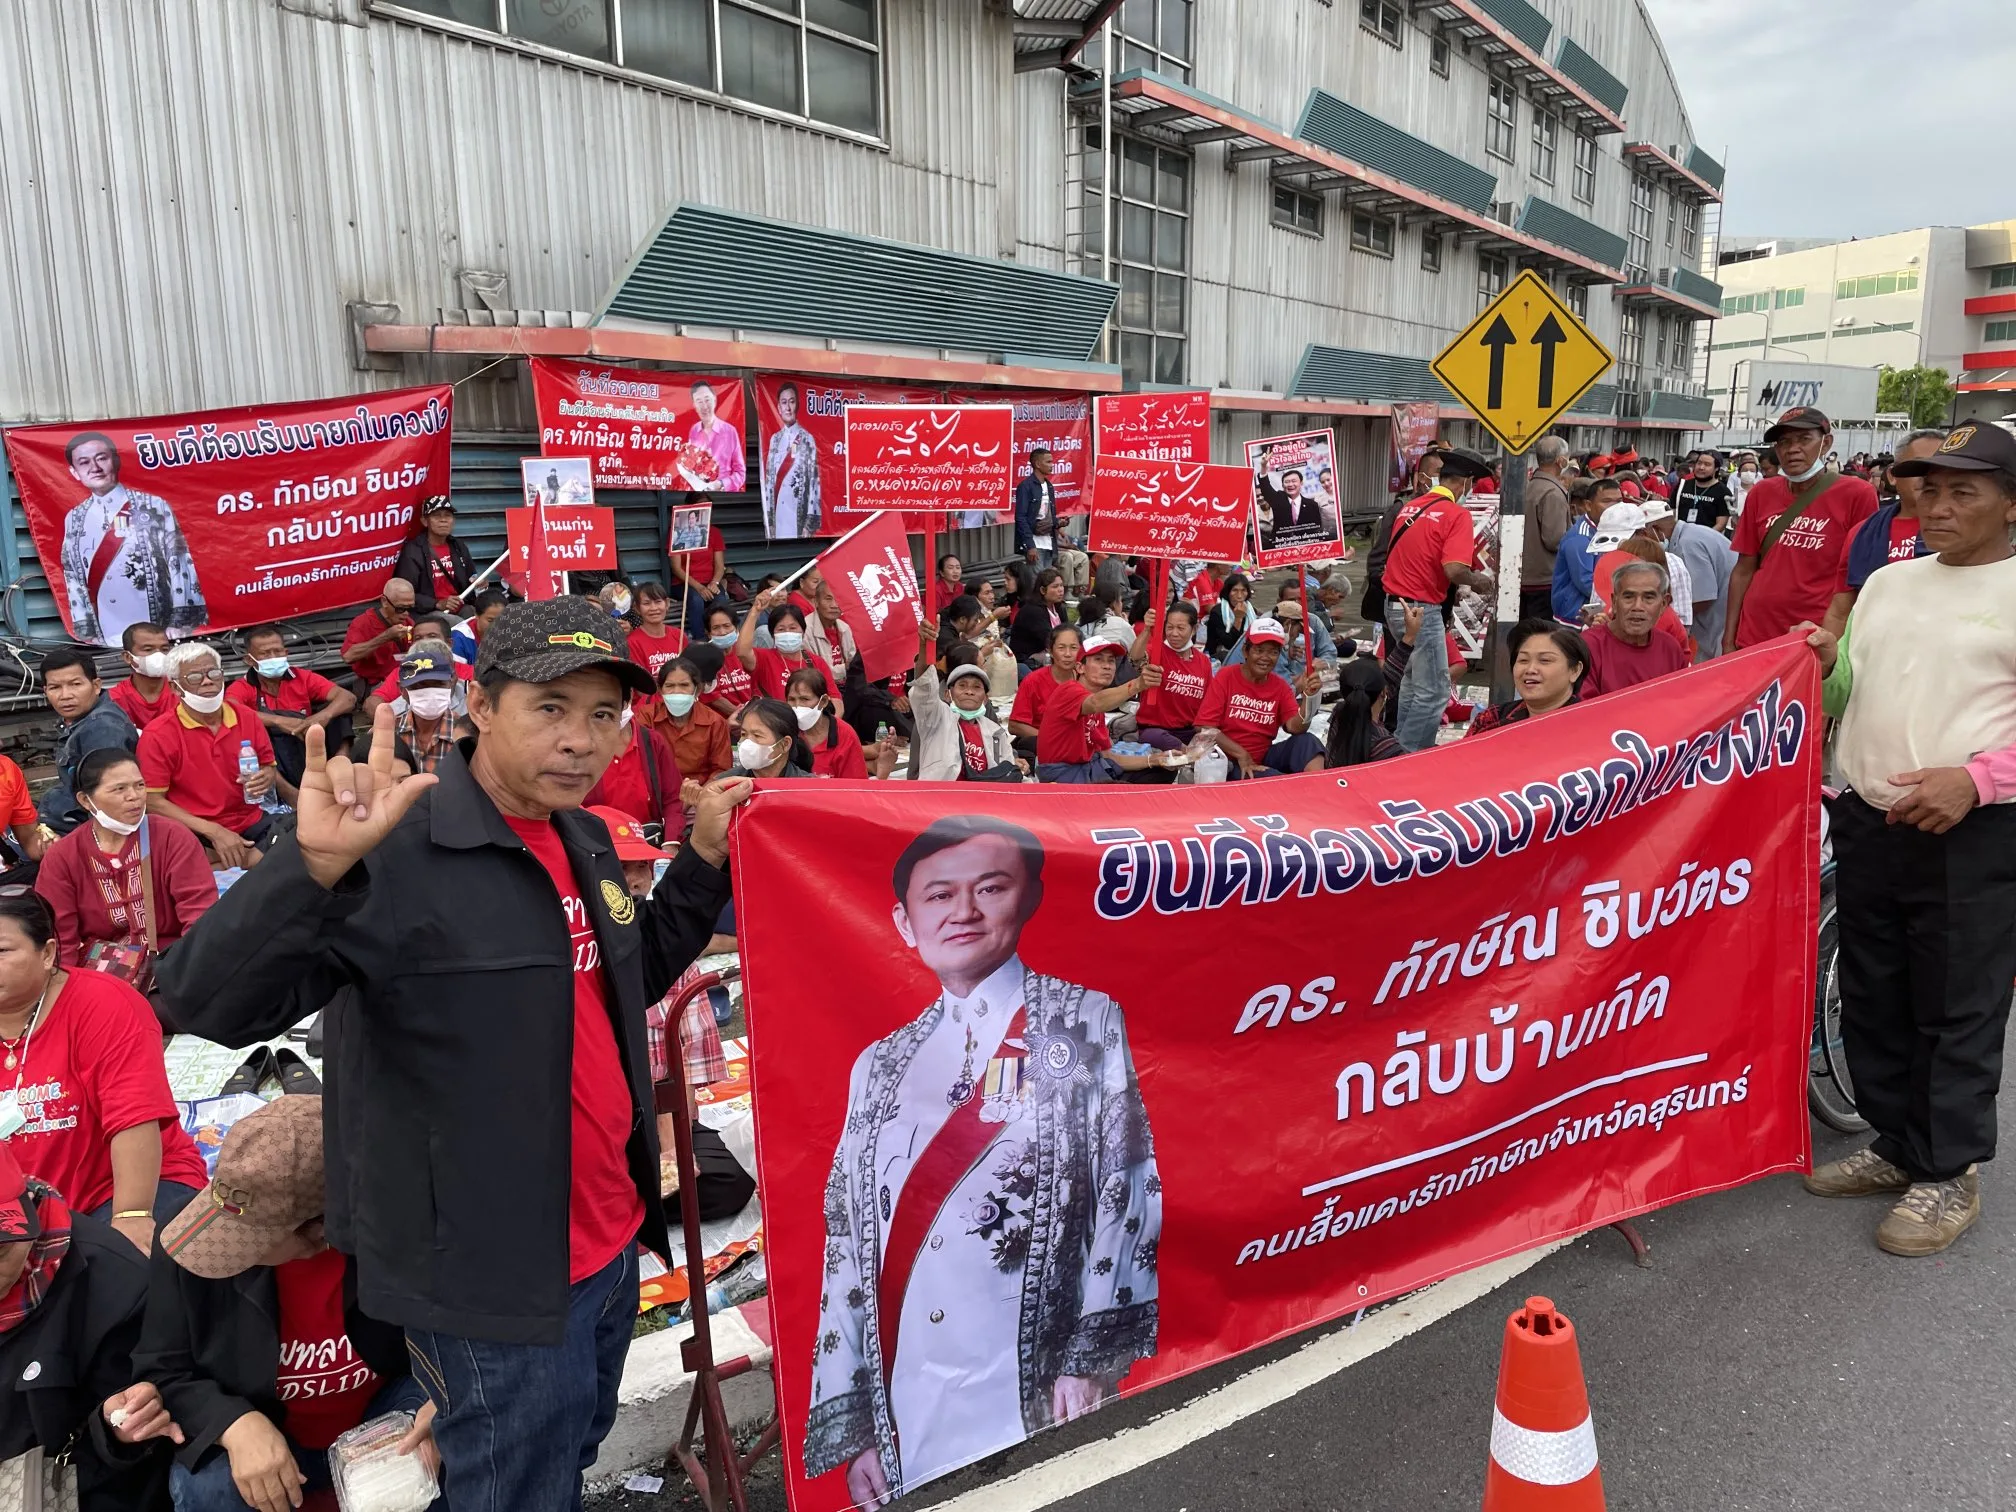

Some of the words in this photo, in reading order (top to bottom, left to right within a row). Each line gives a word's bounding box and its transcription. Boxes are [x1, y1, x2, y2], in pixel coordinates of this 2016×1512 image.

[577, 369, 660, 398] วันที่รอคอย
[1756, 379, 1824, 414] MJETS
[543, 421, 625, 448] ดร.ทักษิณ
[630, 425, 683, 452] ชินวัตร
[877, 409, 1001, 459] เพื่อไทย
[217, 491, 263, 515] ดร.
[274, 475, 357, 507] ทักษิณ
[365, 463, 430, 493] ชินวัต
[592, 471, 642, 486] .หนองบัวแดง
[1119, 463, 1240, 512] เพื่อไทย
[267, 502, 414, 548] กลับบ้านเกิด
[530, 516, 594, 531] อนแก่น
[521, 533, 587, 559] ขวนที่
[595, 544, 606, 558] 7
[1229, 707, 1275, 725] LANDSLIDE
[1094, 681, 1805, 920] ยินดีต้อนรับนายกในดวงใจ
[1233, 974, 1346, 1035] ดร.
[1373, 911, 1559, 1006] ทักษิณ
[1582, 857, 1752, 949] ชินวัตร
[1334, 972, 1671, 1121] กลับบ้านเกิด
[1235, 1065, 1752, 1266] คนเสื้อแดงรักทักษิณจังหวัดสุรินทร์
[276, 1366, 377, 1401] DSLID
